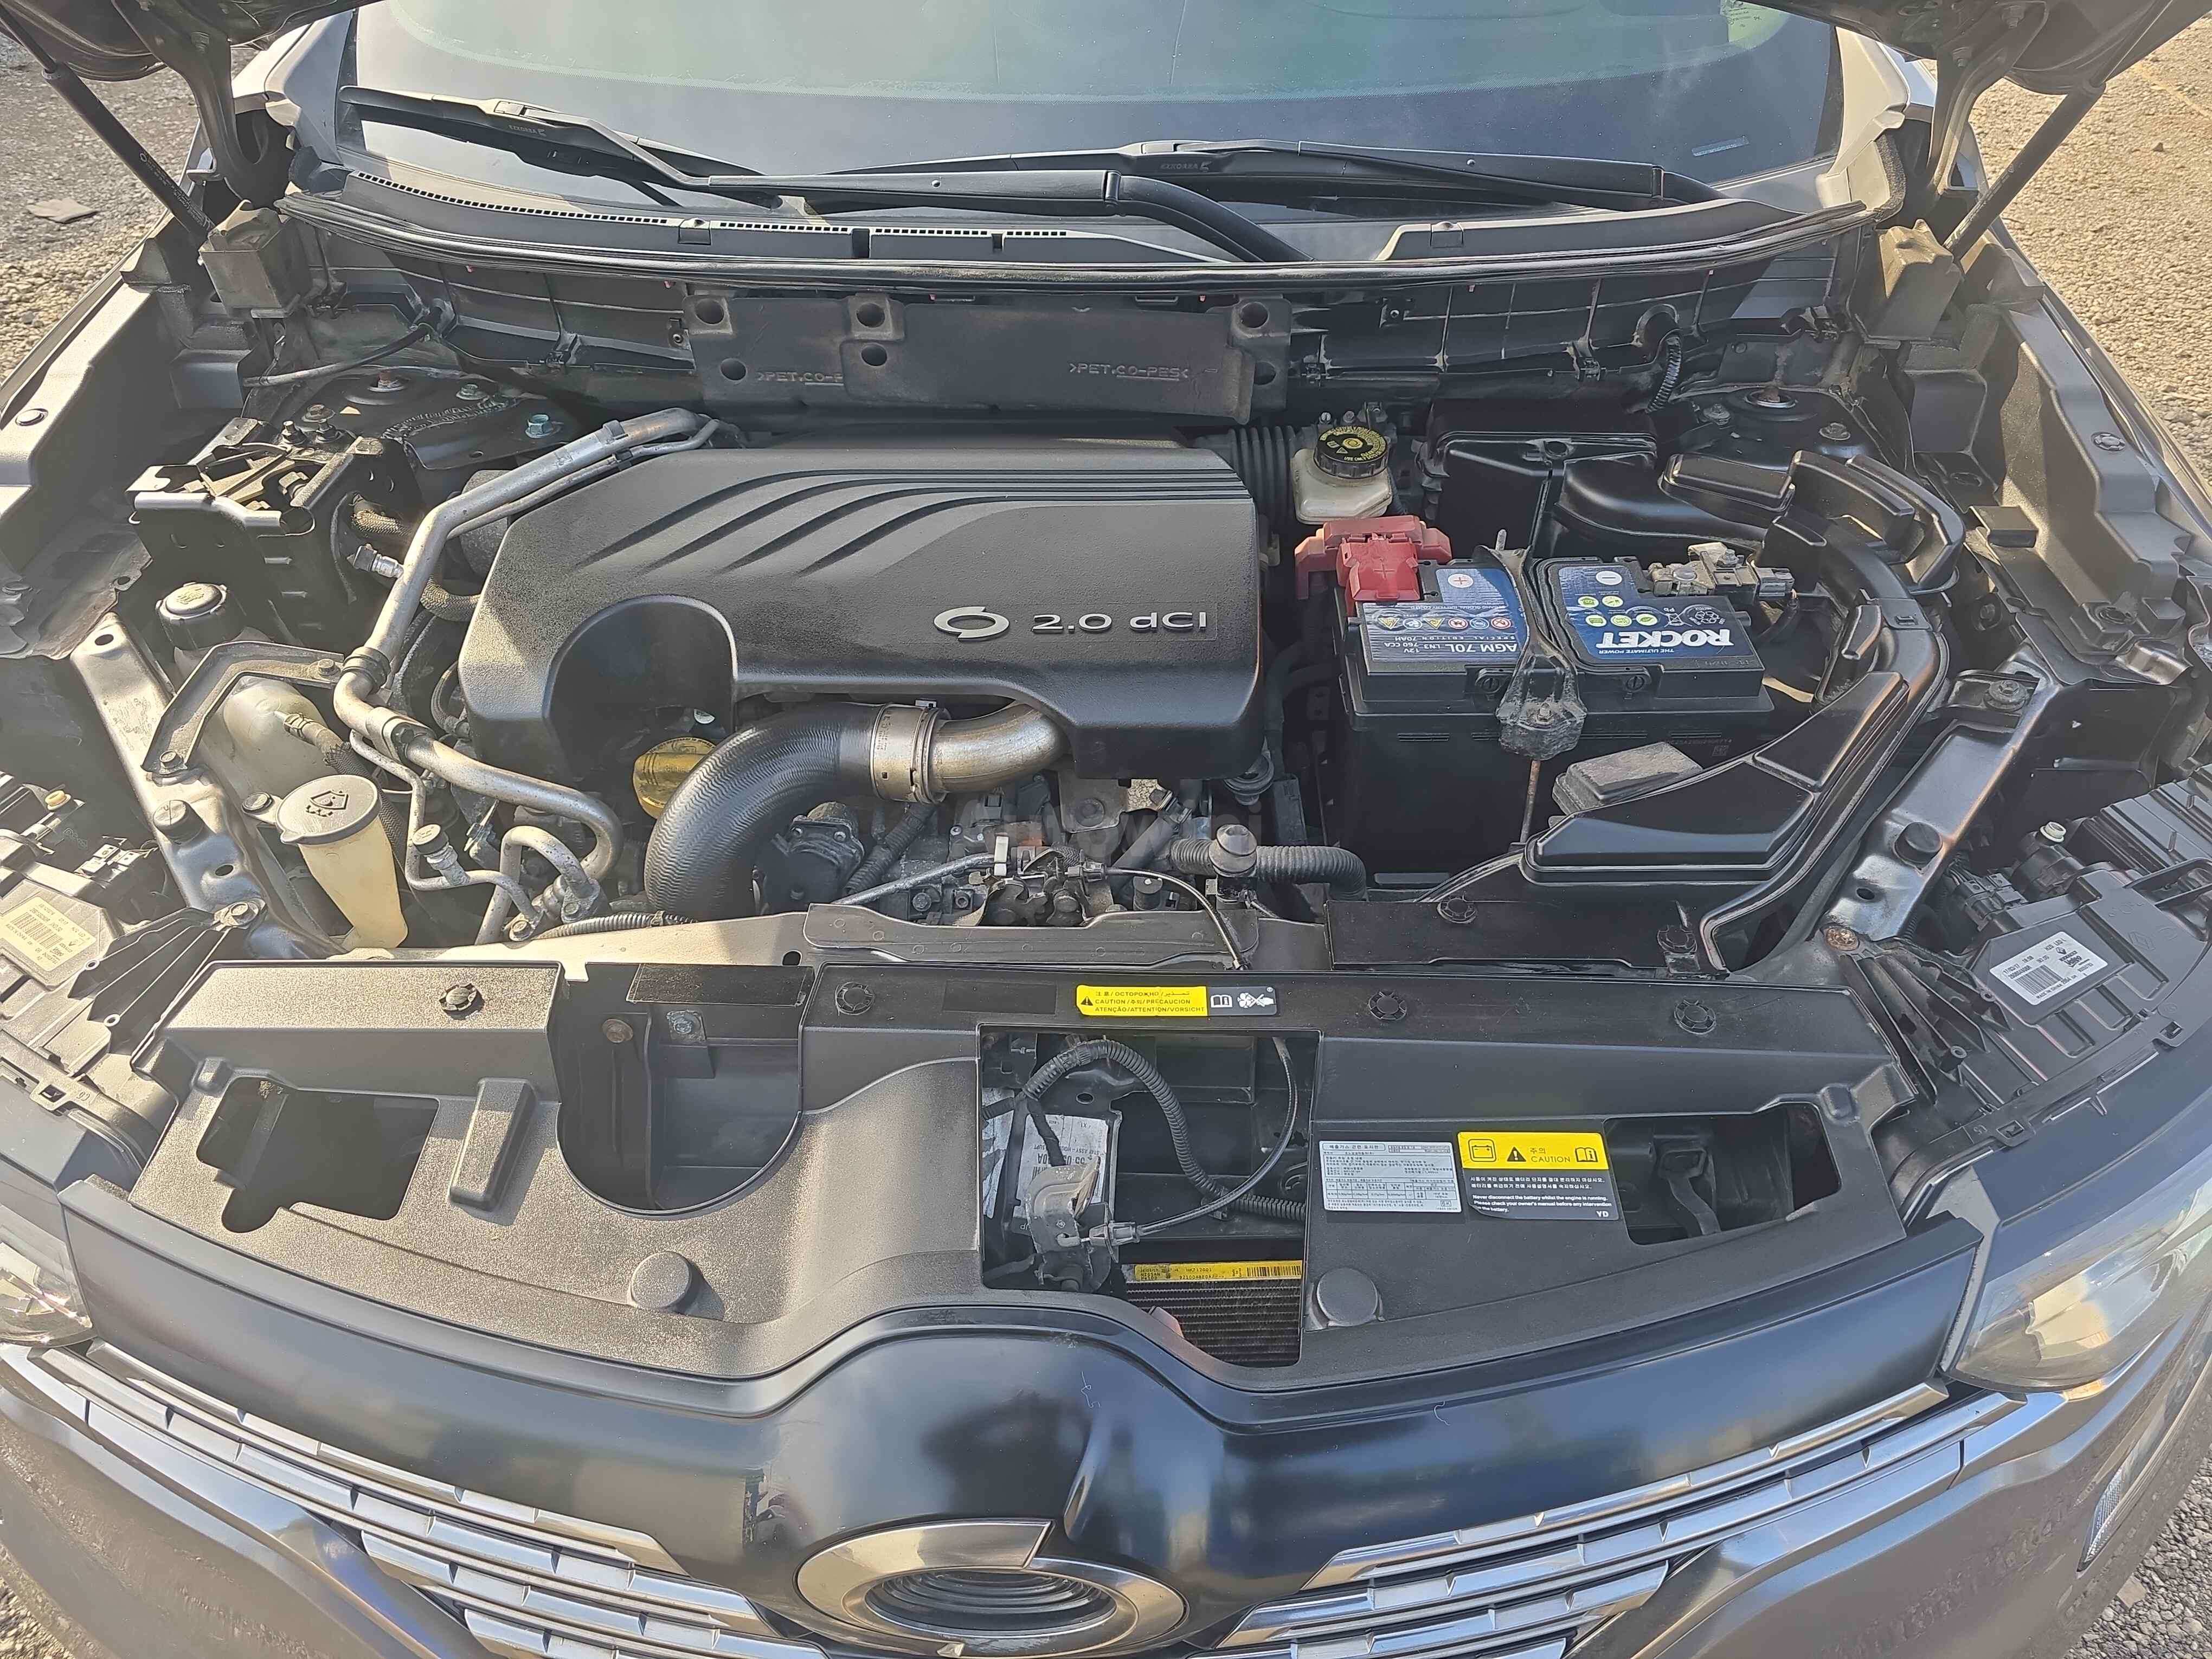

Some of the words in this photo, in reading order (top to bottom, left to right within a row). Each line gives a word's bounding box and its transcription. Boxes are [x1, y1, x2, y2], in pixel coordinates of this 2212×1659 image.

[1032, 613, 1113, 633] 2.0
[1129, 612, 1207, 632] dCI
[1596, 629, 1734, 648] ROCKET
[1445, 644, 1475, 653] 70L
[1481, 644, 1517, 653] AGM
